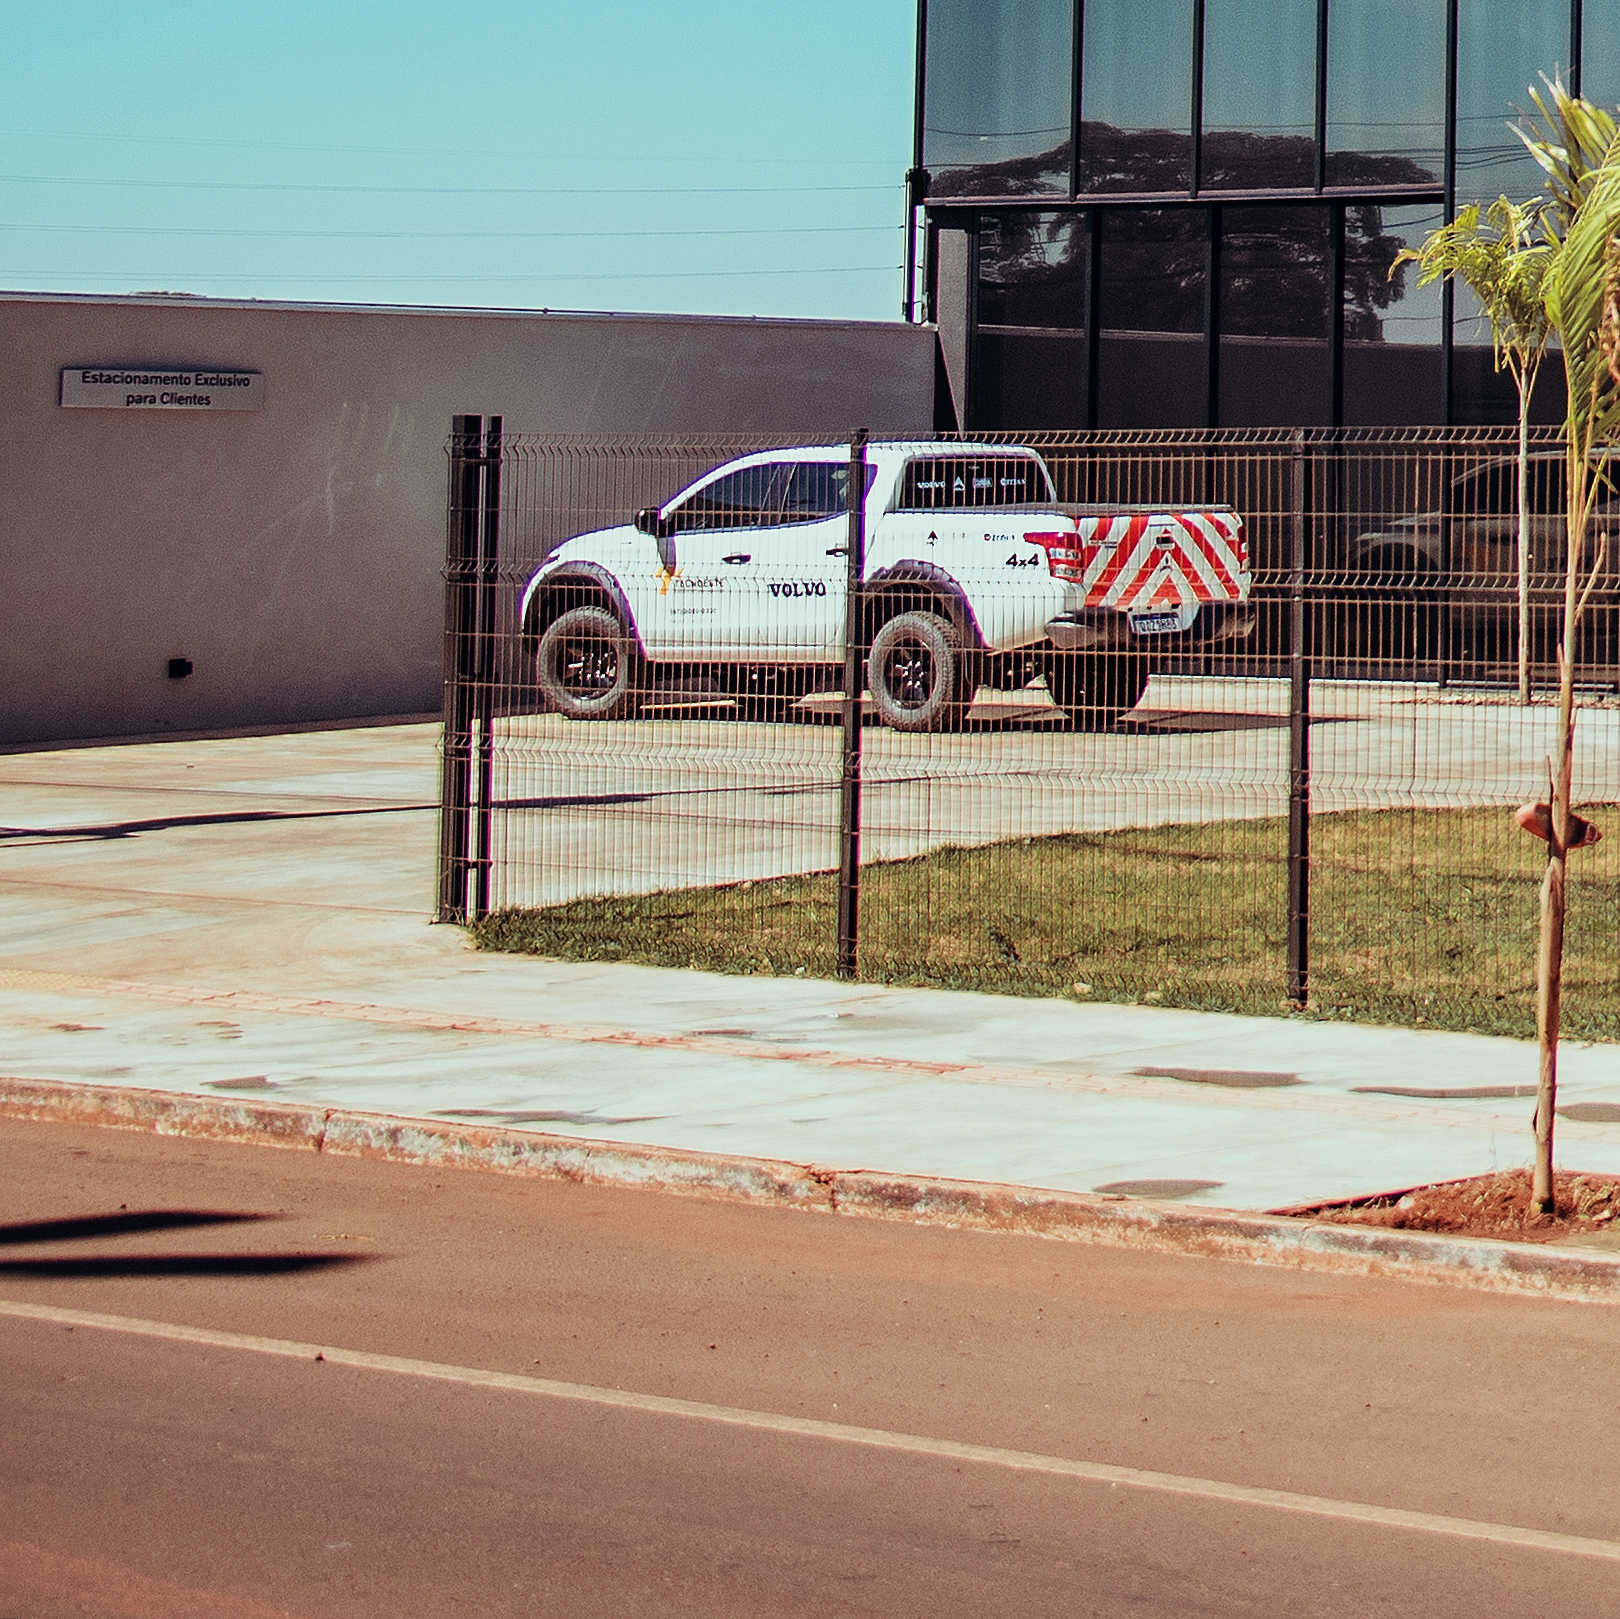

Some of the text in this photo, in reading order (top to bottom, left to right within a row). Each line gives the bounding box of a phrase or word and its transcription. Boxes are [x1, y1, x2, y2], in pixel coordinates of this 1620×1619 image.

[81, 371, 251, 387] Estacionamento Exclusivo
[126, 391, 211, 407] para Clientes
[1005, 553, 1040, 567] 4x4
[769, 582, 827, 598] VOLVO
